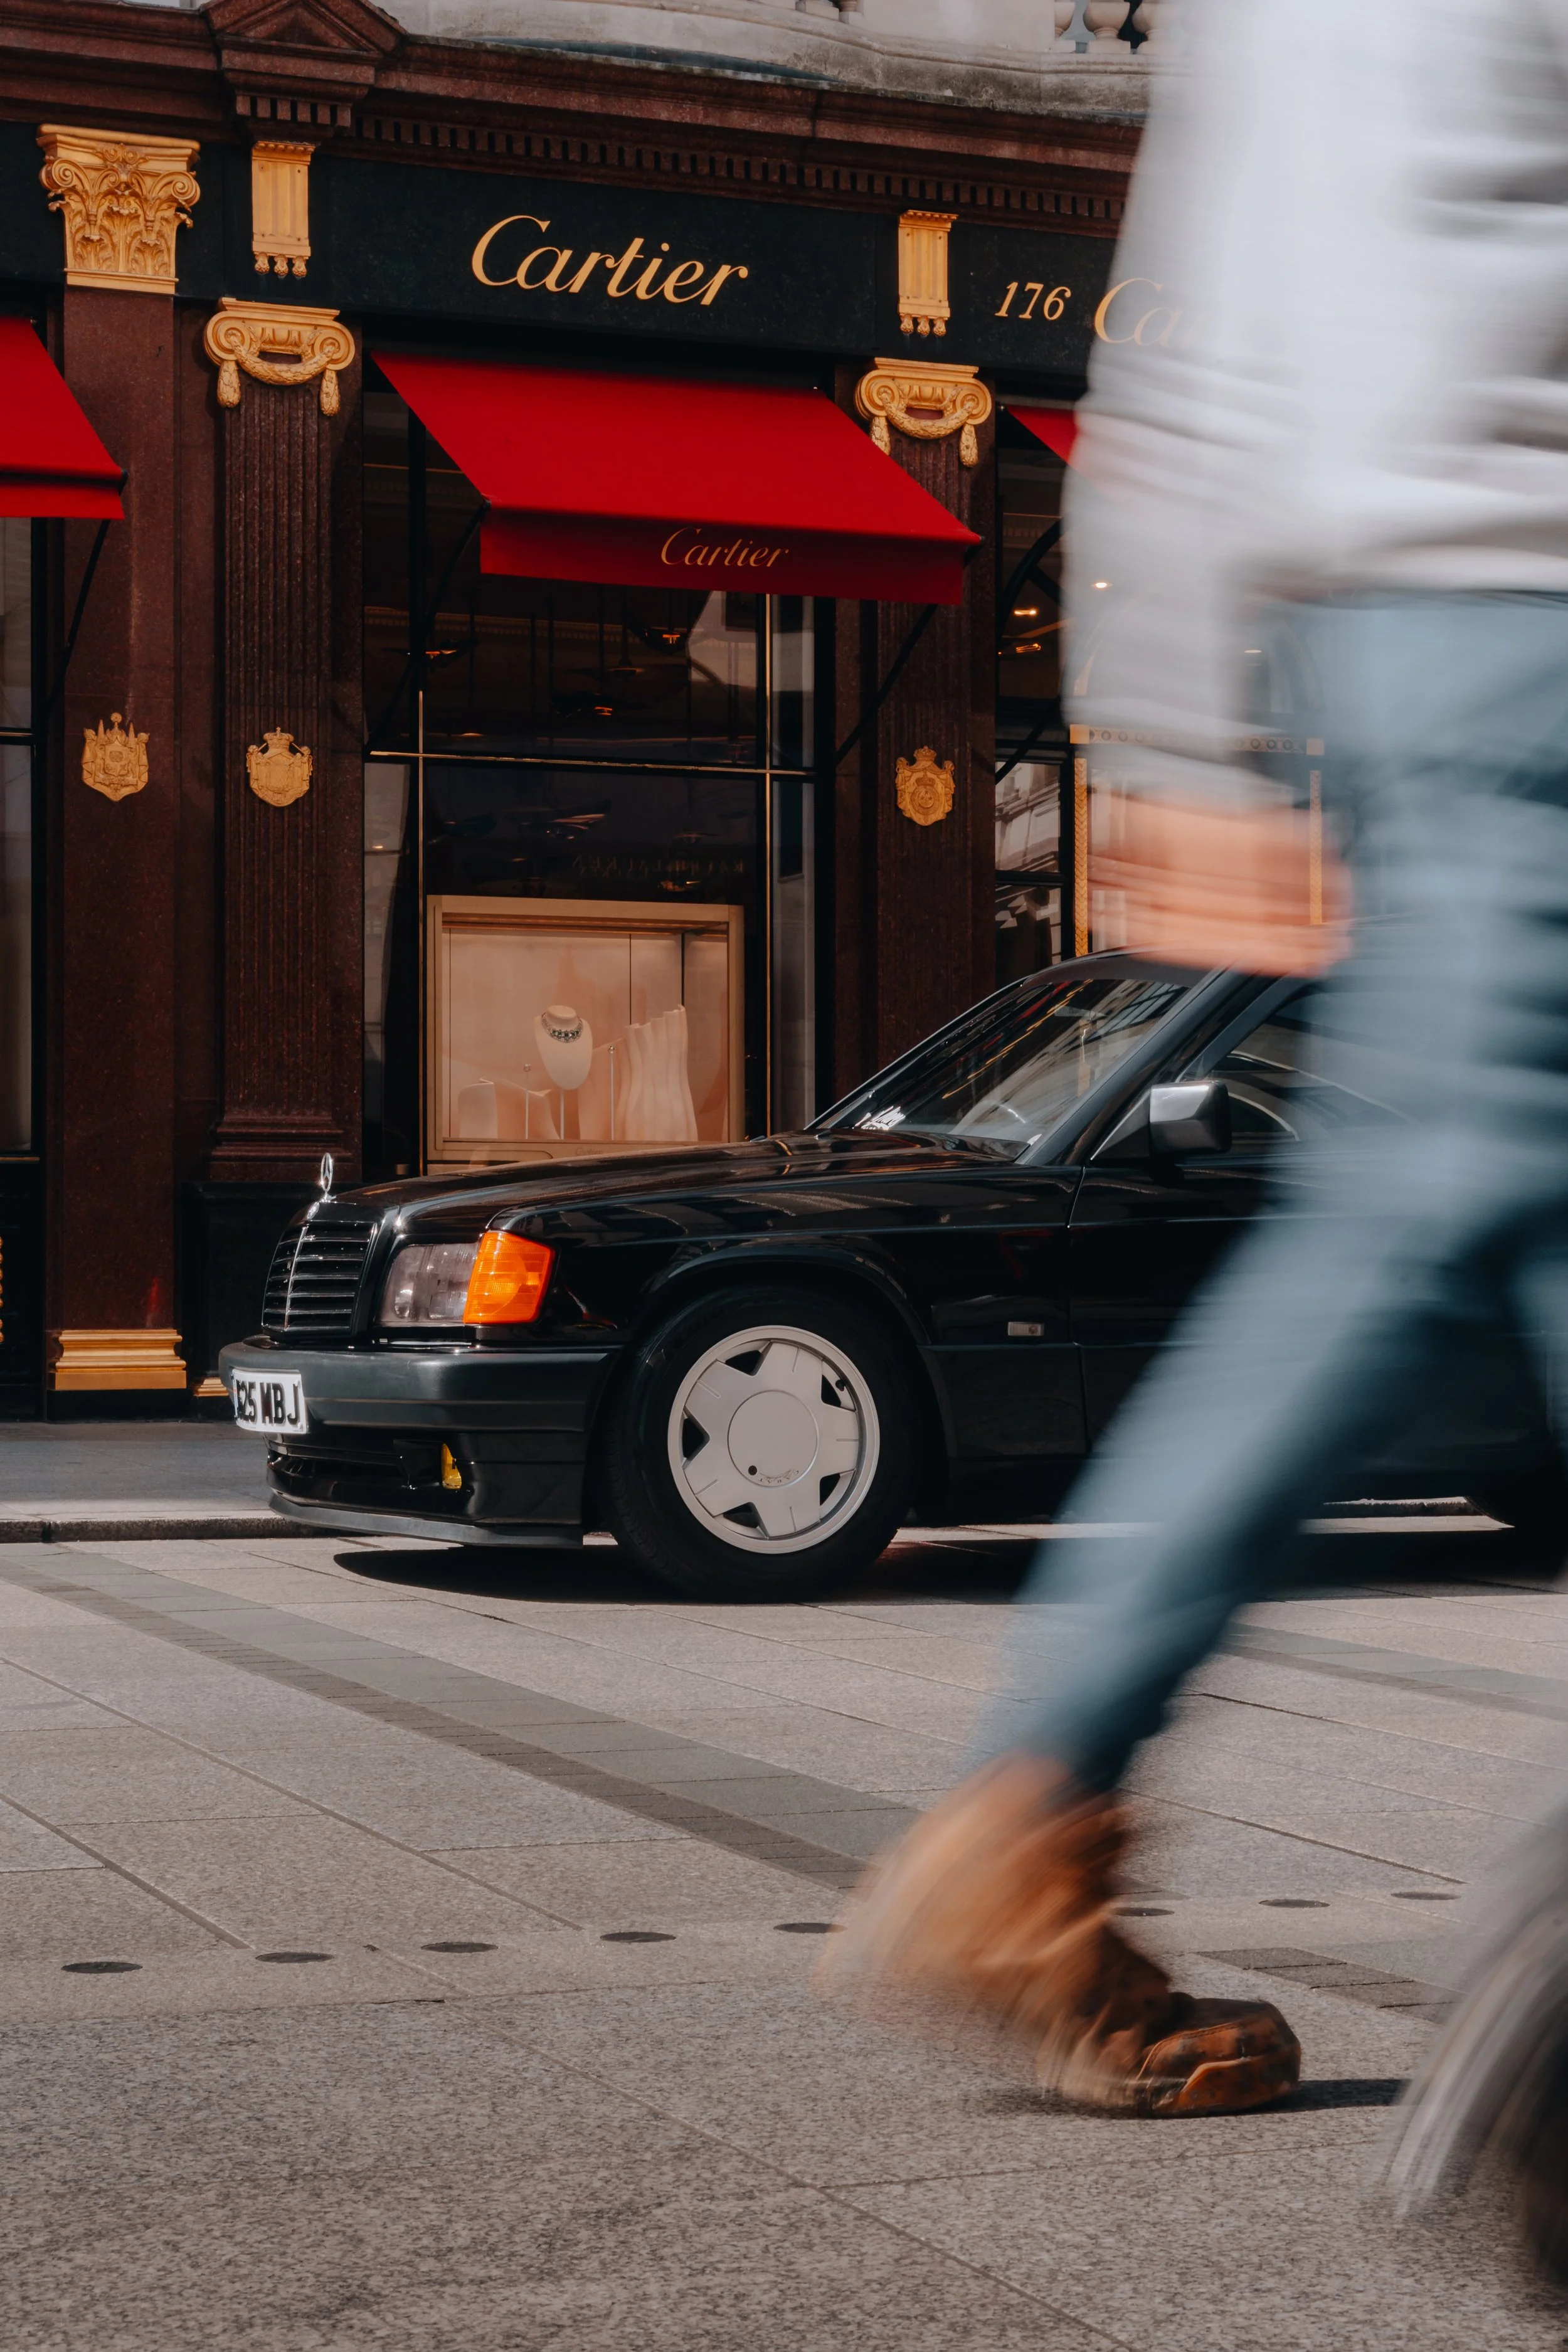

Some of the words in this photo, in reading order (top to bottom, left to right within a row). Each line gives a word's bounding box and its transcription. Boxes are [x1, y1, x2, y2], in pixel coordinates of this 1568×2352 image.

[471, 215, 749, 305] Cartier
[995, 281, 1071, 320] 176
[660, 526, 789, 567] Cartier
[260, 1382, 301, 1426] MBJ
